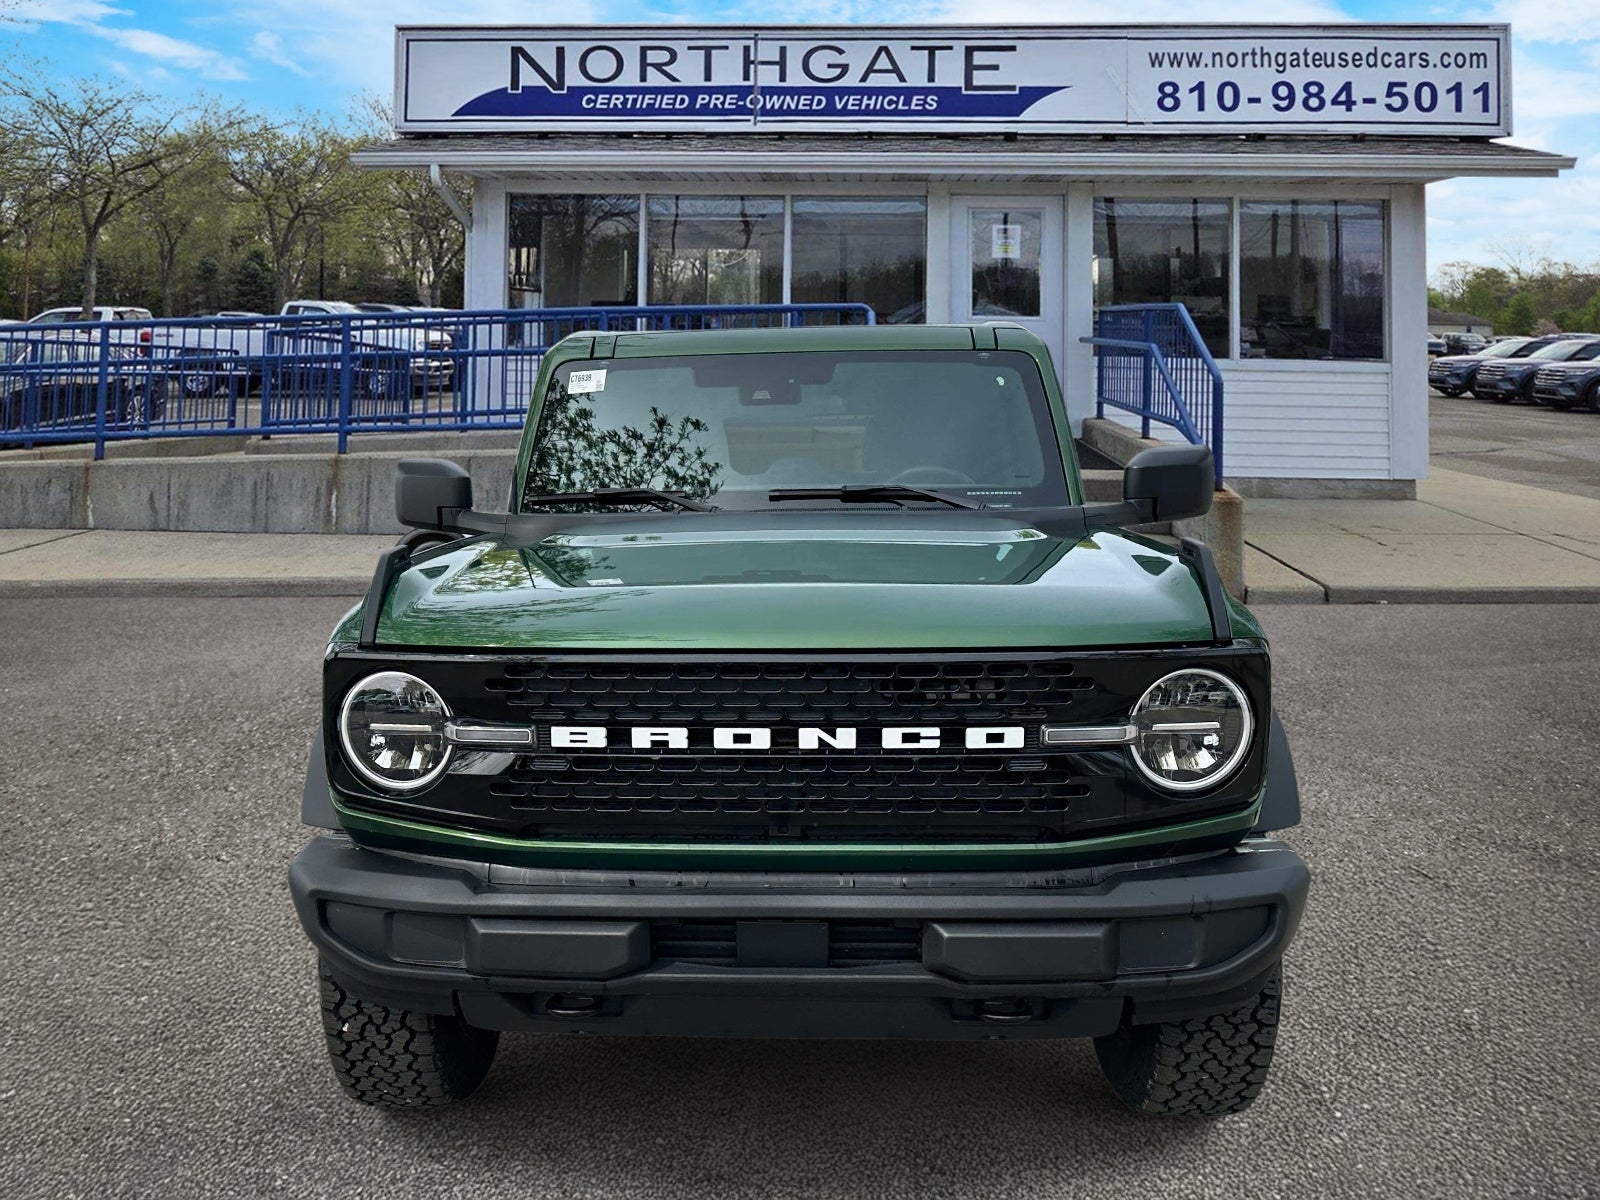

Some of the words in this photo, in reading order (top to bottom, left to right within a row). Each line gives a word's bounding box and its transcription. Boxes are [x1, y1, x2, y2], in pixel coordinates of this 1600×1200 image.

[510, 45, 1018, 92] NORTHGATE
[1149, 47, 1488, 73] www.northgateusedcars.com
[581, 94, 689, 109] CERTIFIED
[695, 94, 827, 110] PRE-OWNED
[834, 95, 938, 110] VEHICLES
[1156, 80, 1491, 113] 810-984-5011
[551, 726, 1026, 749] BRONCO
